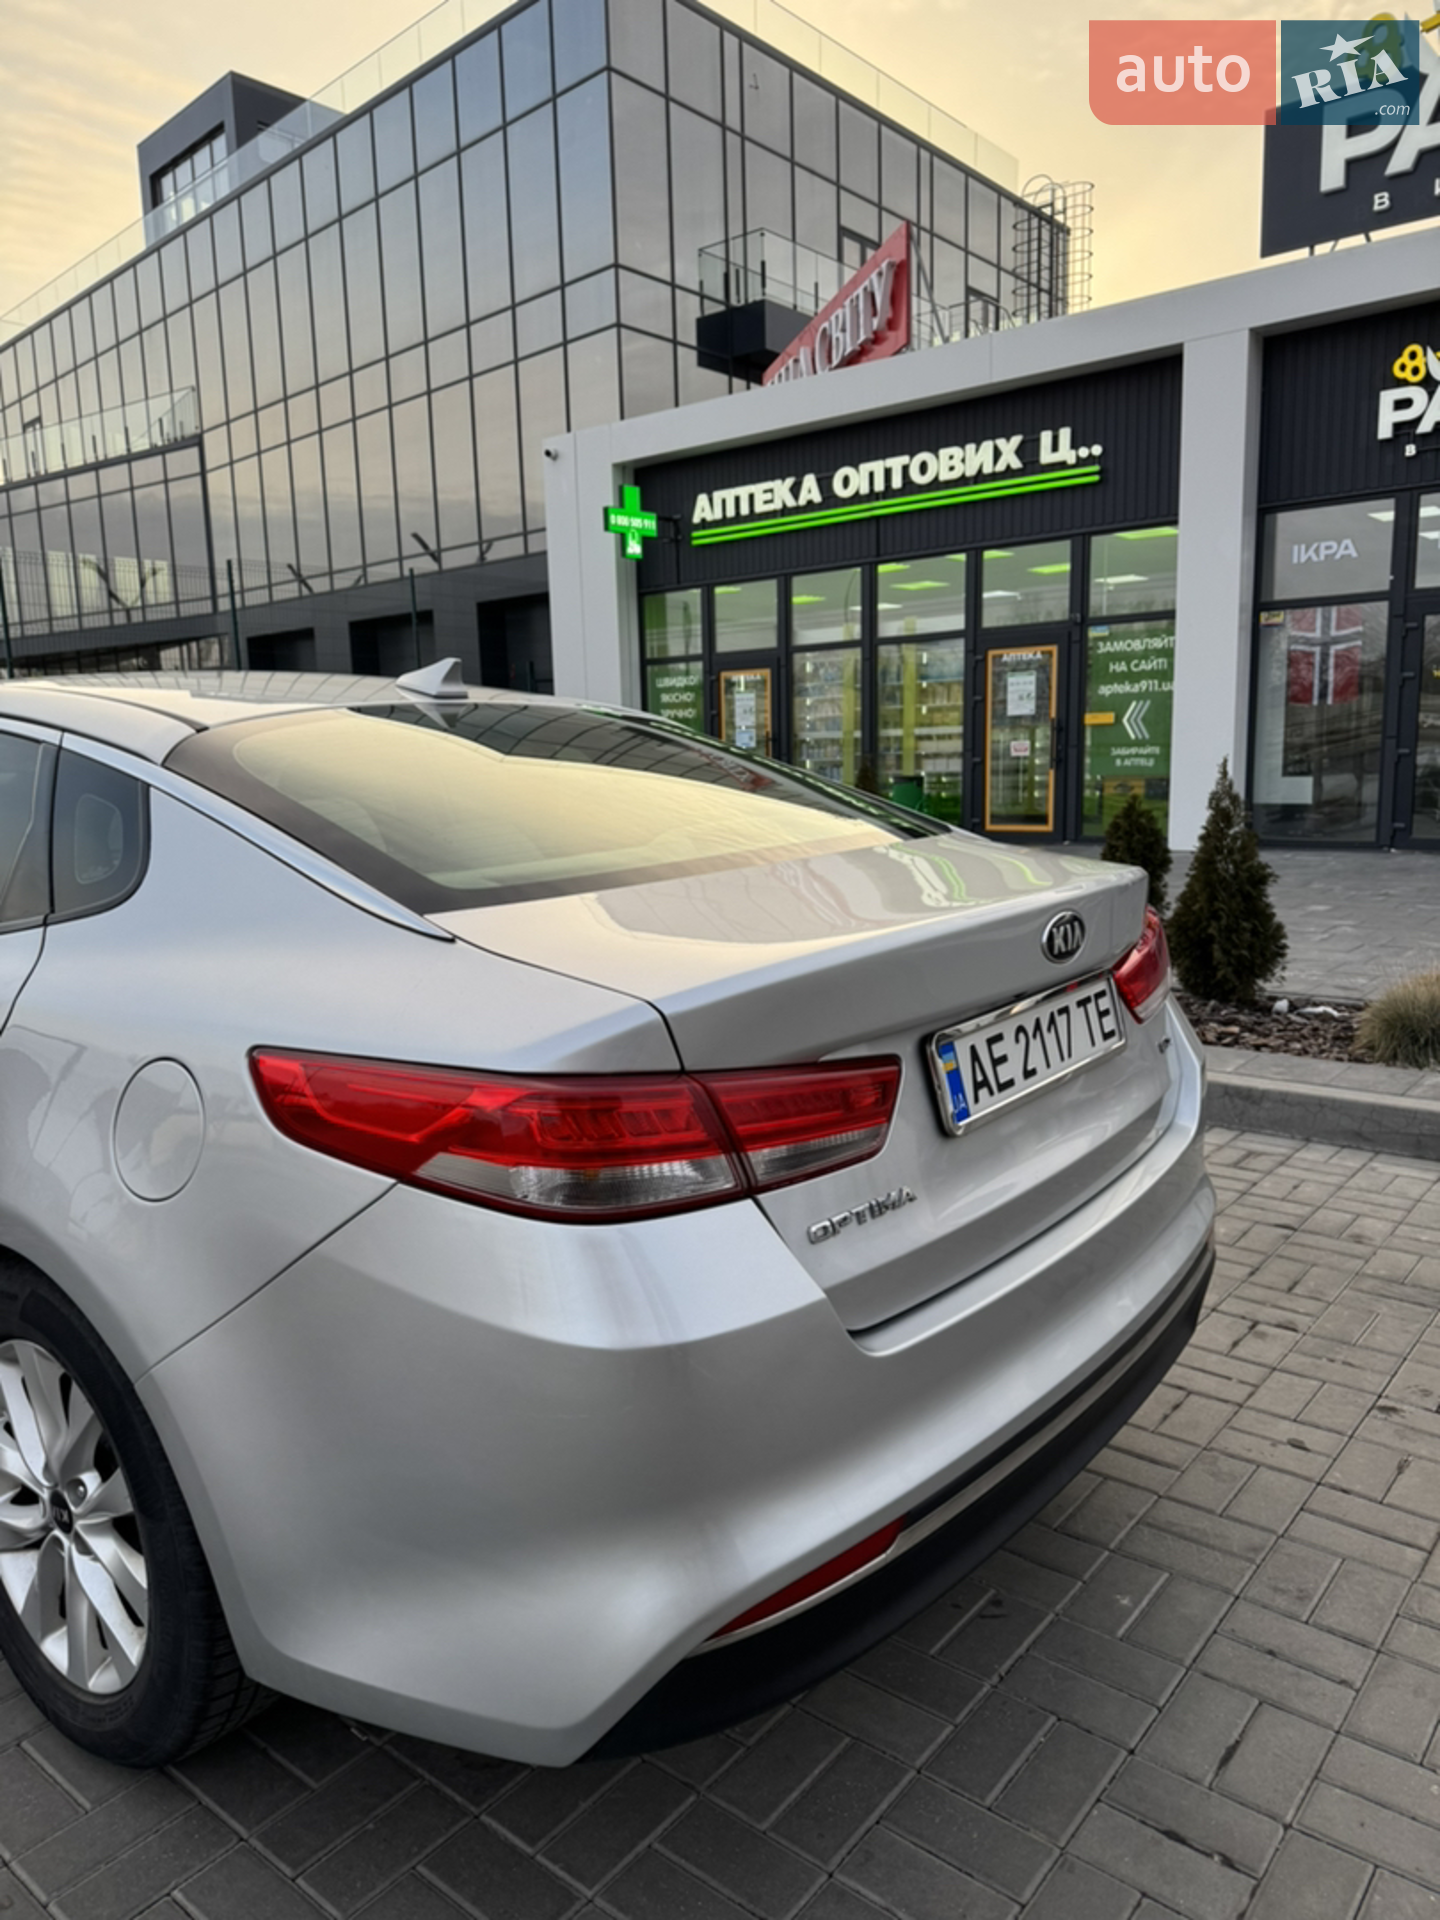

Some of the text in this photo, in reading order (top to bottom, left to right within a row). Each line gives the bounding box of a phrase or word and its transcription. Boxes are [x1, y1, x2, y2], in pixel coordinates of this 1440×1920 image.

[691, 472, 823, 525] АПТЕКА
[831, 433, 1025, 499] ОПТОВИХ
[1109, 661, 1128, 673] НА
[1052, 920, 1083, 956] KIA
[970, 989, 1117, 1105] AE 2117 TE
[806, 1185, 918, 1245] OPTIMA
